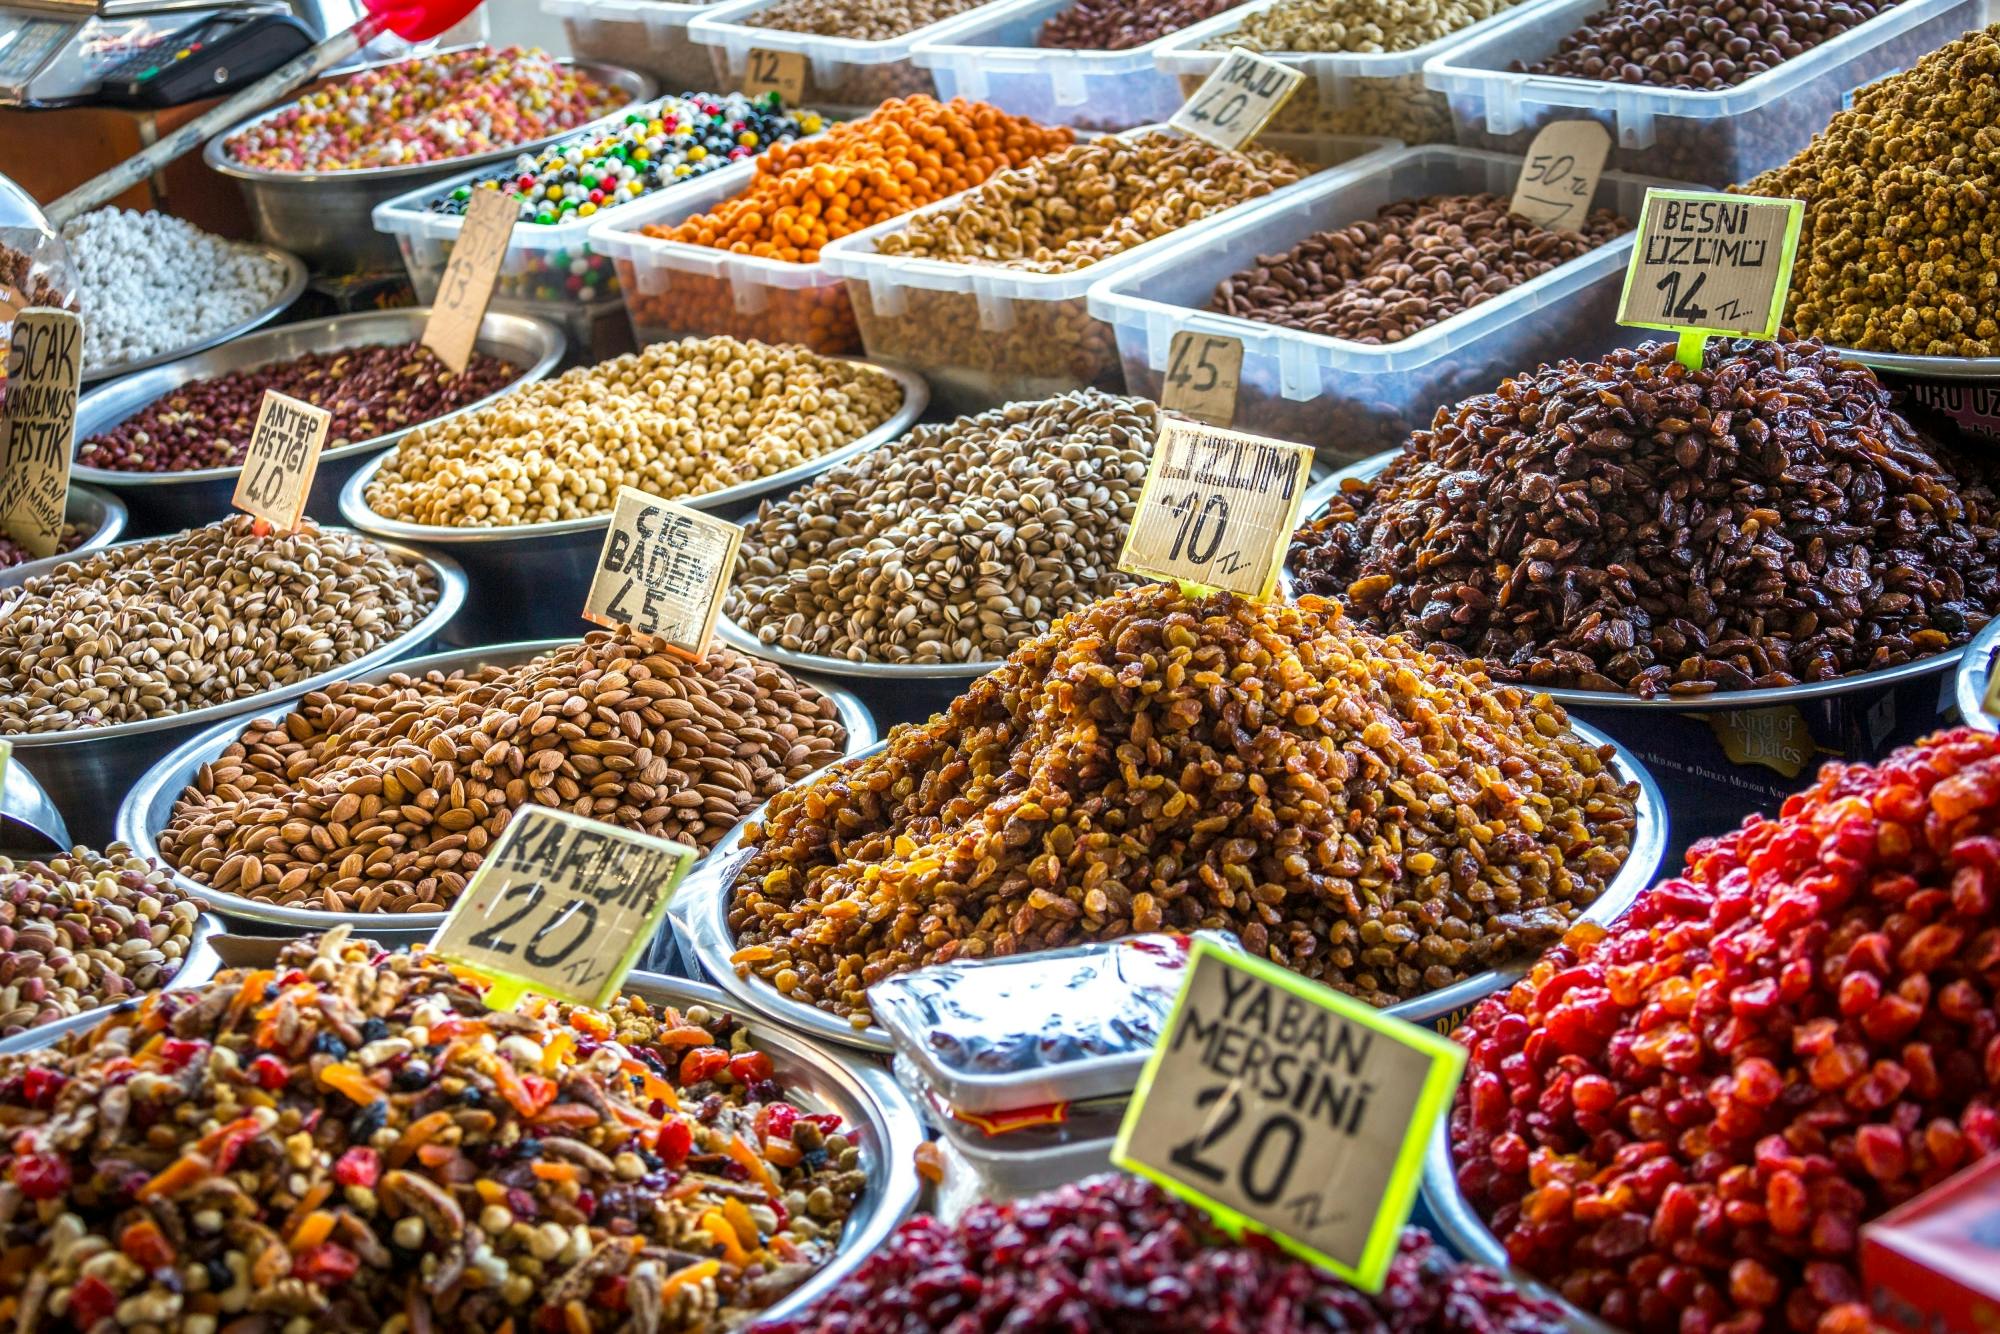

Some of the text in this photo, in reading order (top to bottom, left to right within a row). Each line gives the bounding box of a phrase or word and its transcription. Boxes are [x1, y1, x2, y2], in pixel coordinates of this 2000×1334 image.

[752, 52, 779, 84] 12
[1189, 88, 1248, 126] 40
[1525, 155, 1575, 186] 50
[1663, 201, 1750, 235] BESNİ
[1645, 235, 1767, 267] ÜZÜMÜ
[1656, 271, 1708, 324] 14
[8, 321, 77, 387] SICAK
[1167, 336, 1230, 392] 45
[6, 420, 71, 473] FISTIK
[265, 401, 319, 443] ANTEP
[245, 460, 284, 509] 40
[605, 577, 667, 634] 45
[1729, 710, 1798, 740] King of
[1737, 728, 1801, 764] Dates
[468, 881, 599, 968] 20
[1219, 965, 1374, 1076] YABAN
[1171, 1006, 1374, 1138] MERSİNİ
[1169, 1084, 1304, 1207] 20
